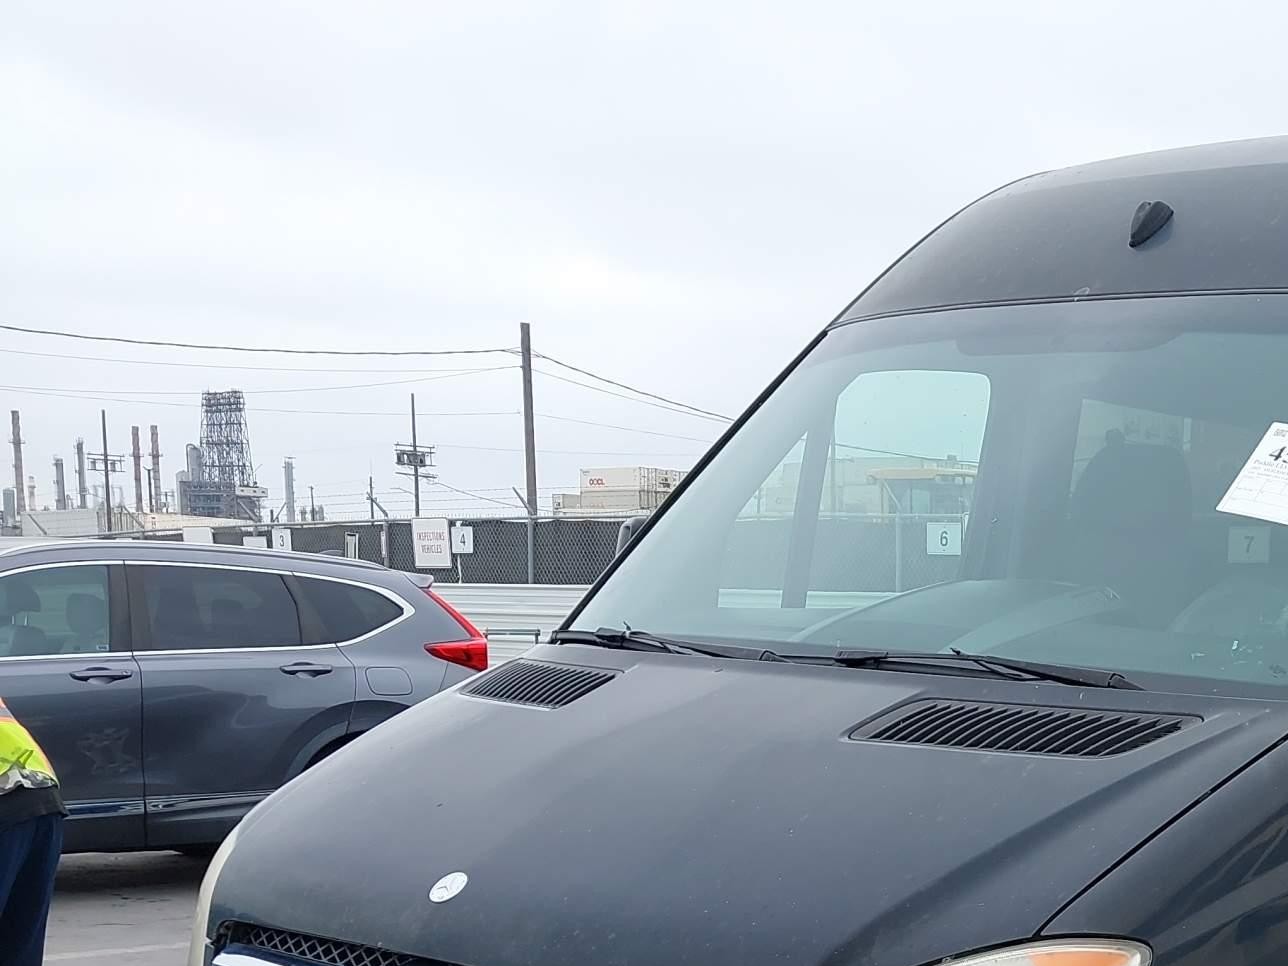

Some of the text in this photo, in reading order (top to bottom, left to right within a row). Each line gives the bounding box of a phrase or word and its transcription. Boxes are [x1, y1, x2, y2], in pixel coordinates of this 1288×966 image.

[589, 478, 605, 486] OOCL
[279, 535, 284, 547] 3
[459, 532, 466, 547] 4
[940, 530, 948, 547] 6
[1244, 535, 1255, 553] 7
[421, 544, 442, 554] VEHICLES
